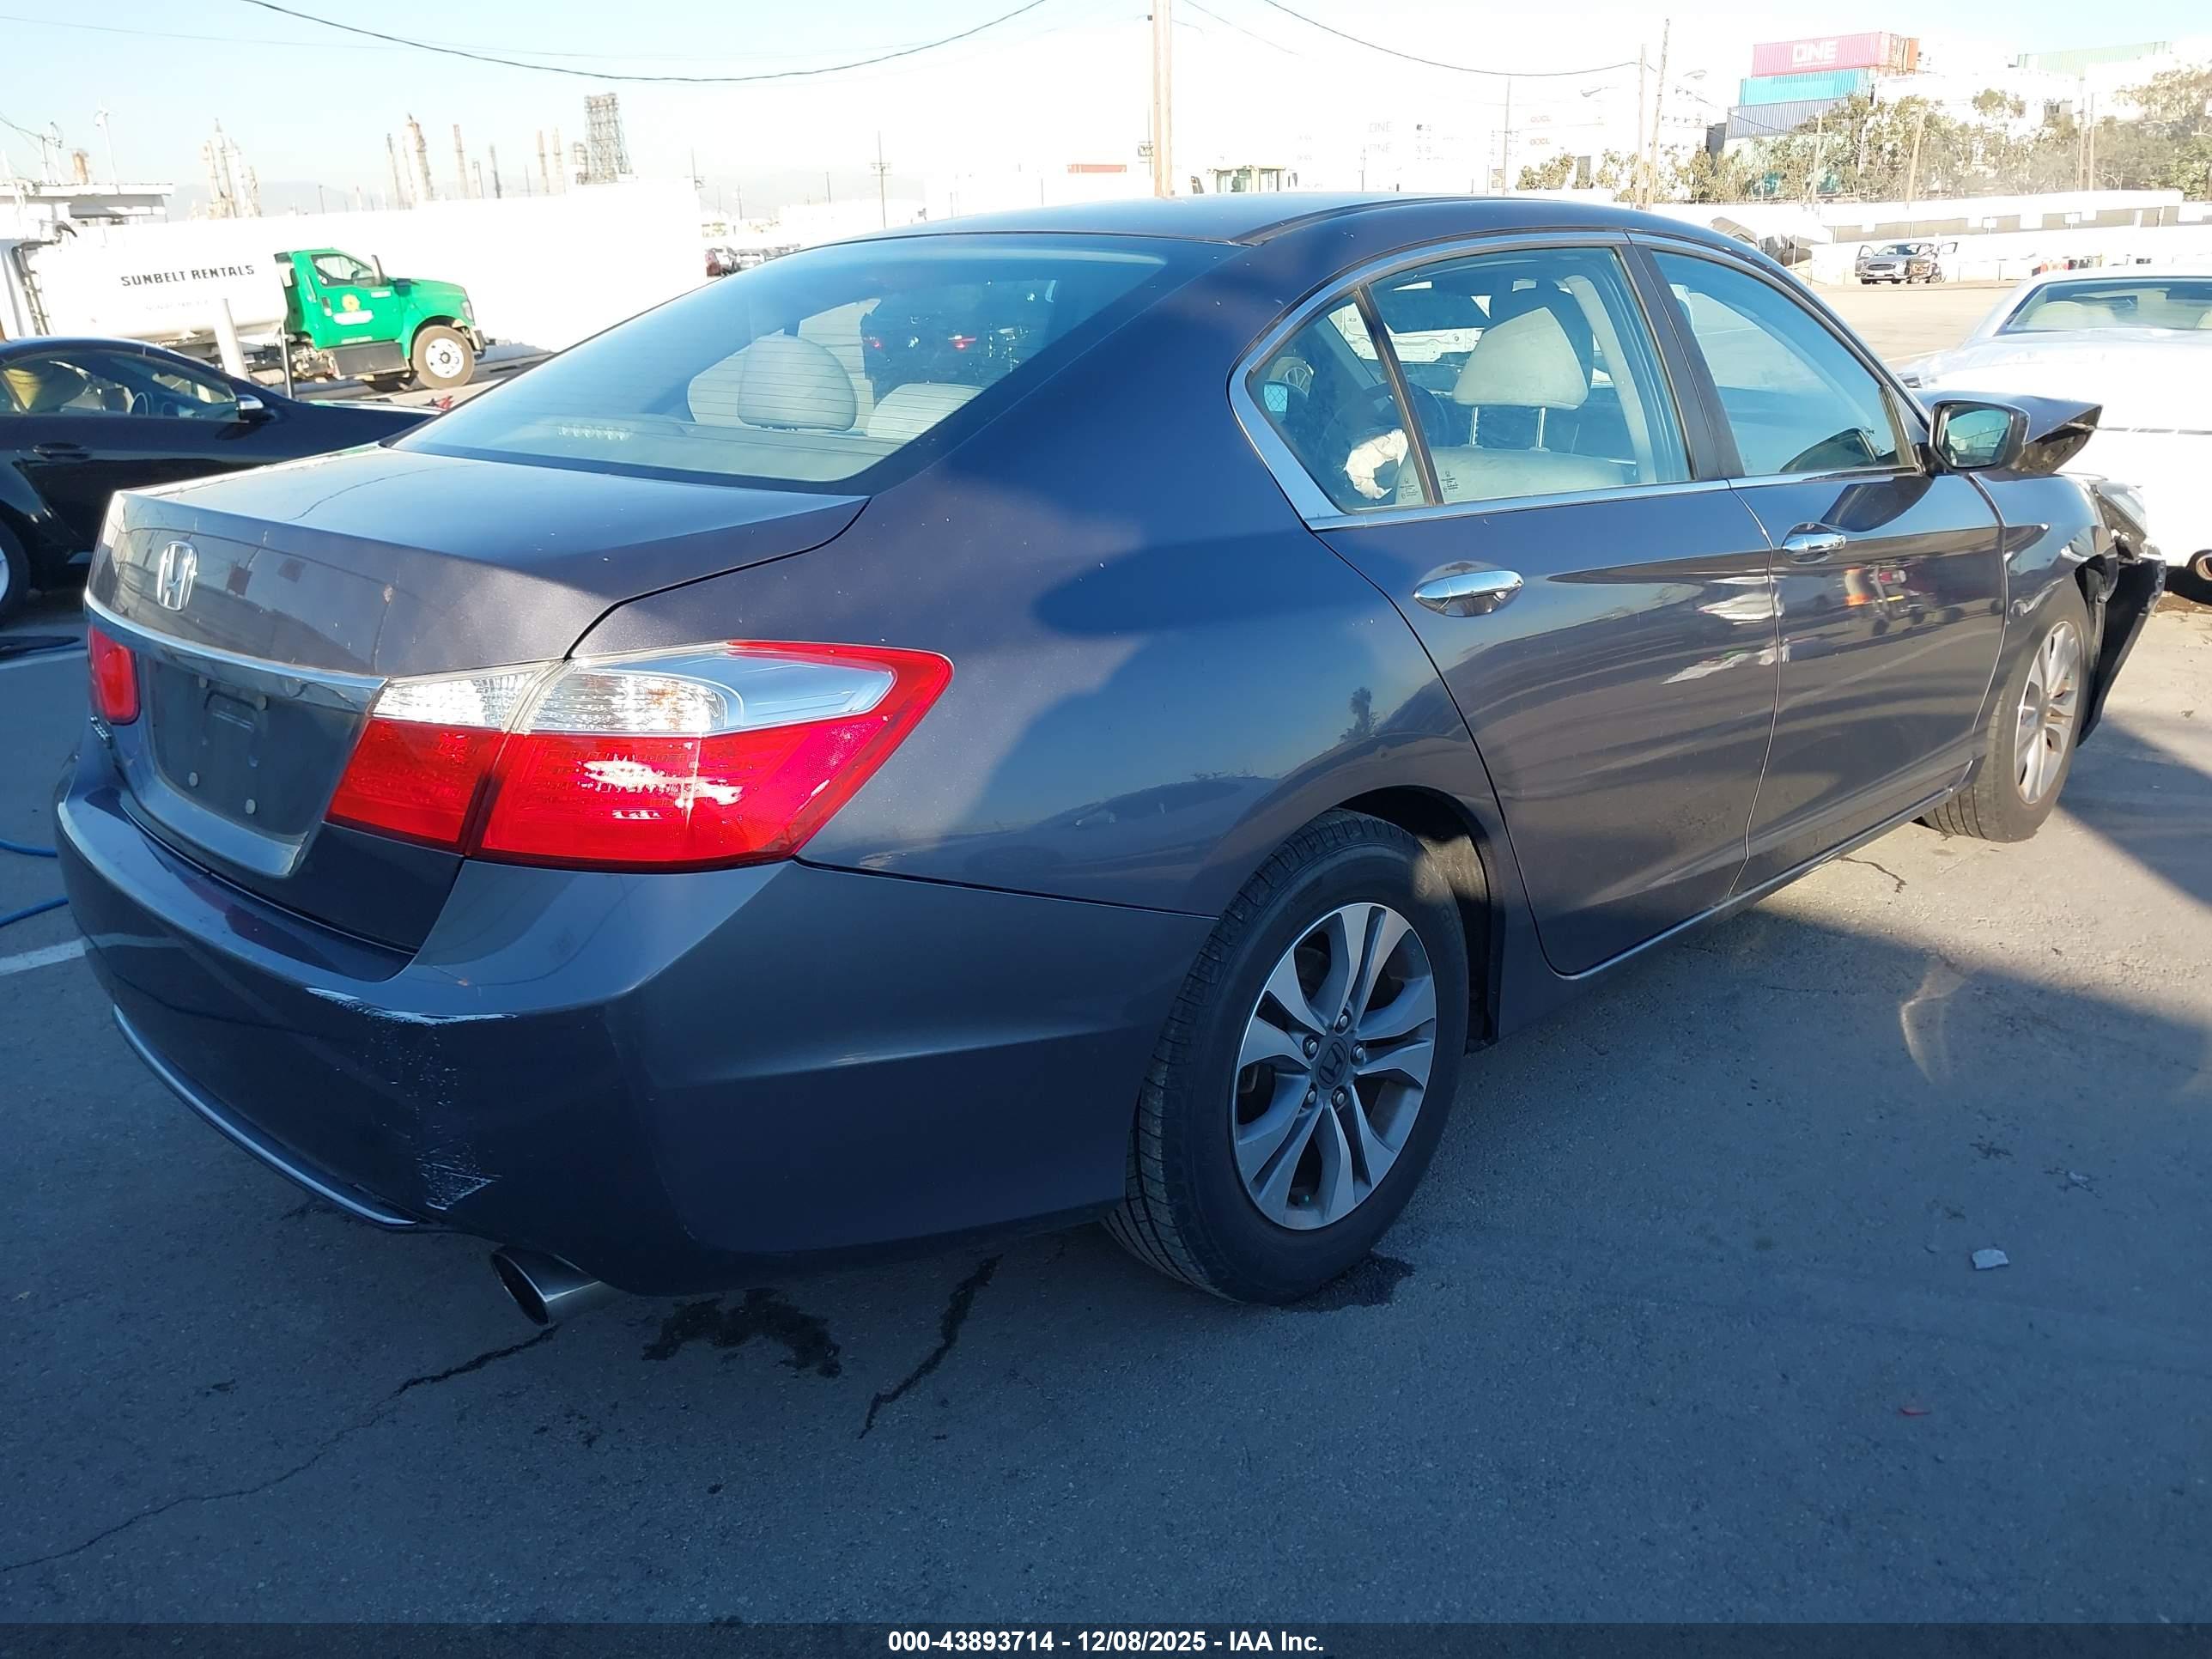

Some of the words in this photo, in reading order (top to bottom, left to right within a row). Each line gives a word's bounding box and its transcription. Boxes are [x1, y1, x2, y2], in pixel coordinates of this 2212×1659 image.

[1793, 40, 1838, 63] ONE
[120, 270, 185, 287] SUNBELT
[191, 264, 255, 280] RENTALS
